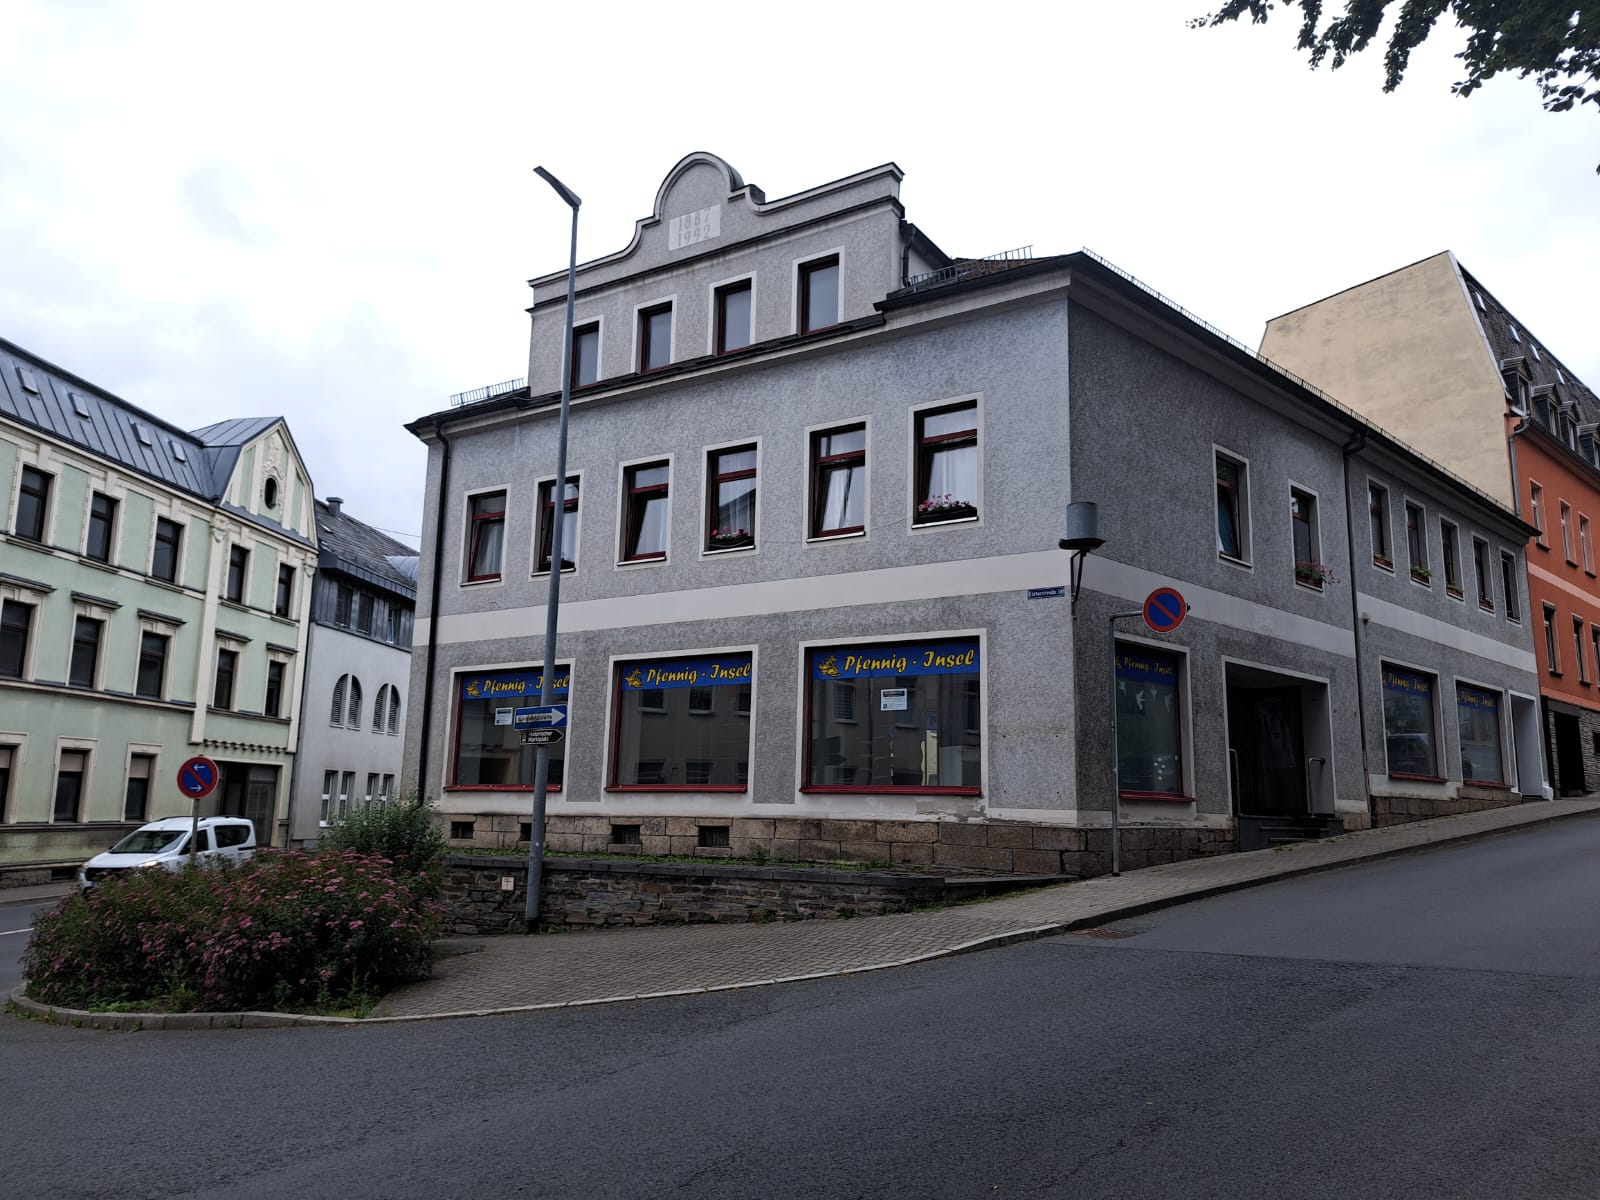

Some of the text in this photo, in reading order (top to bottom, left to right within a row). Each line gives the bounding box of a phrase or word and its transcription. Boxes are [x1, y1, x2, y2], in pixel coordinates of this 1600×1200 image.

[678, 225, 711, 247] 1992
[844, 654, 908, 675] Pfennig
[923, 649, 975, 668] Insel
[483, 677, 526, 695] Pfennig
[535, 674, 570, 690] Isel
[646, 666, 698, 685] Pfennig
[710, 662, 751, 680] Insel
